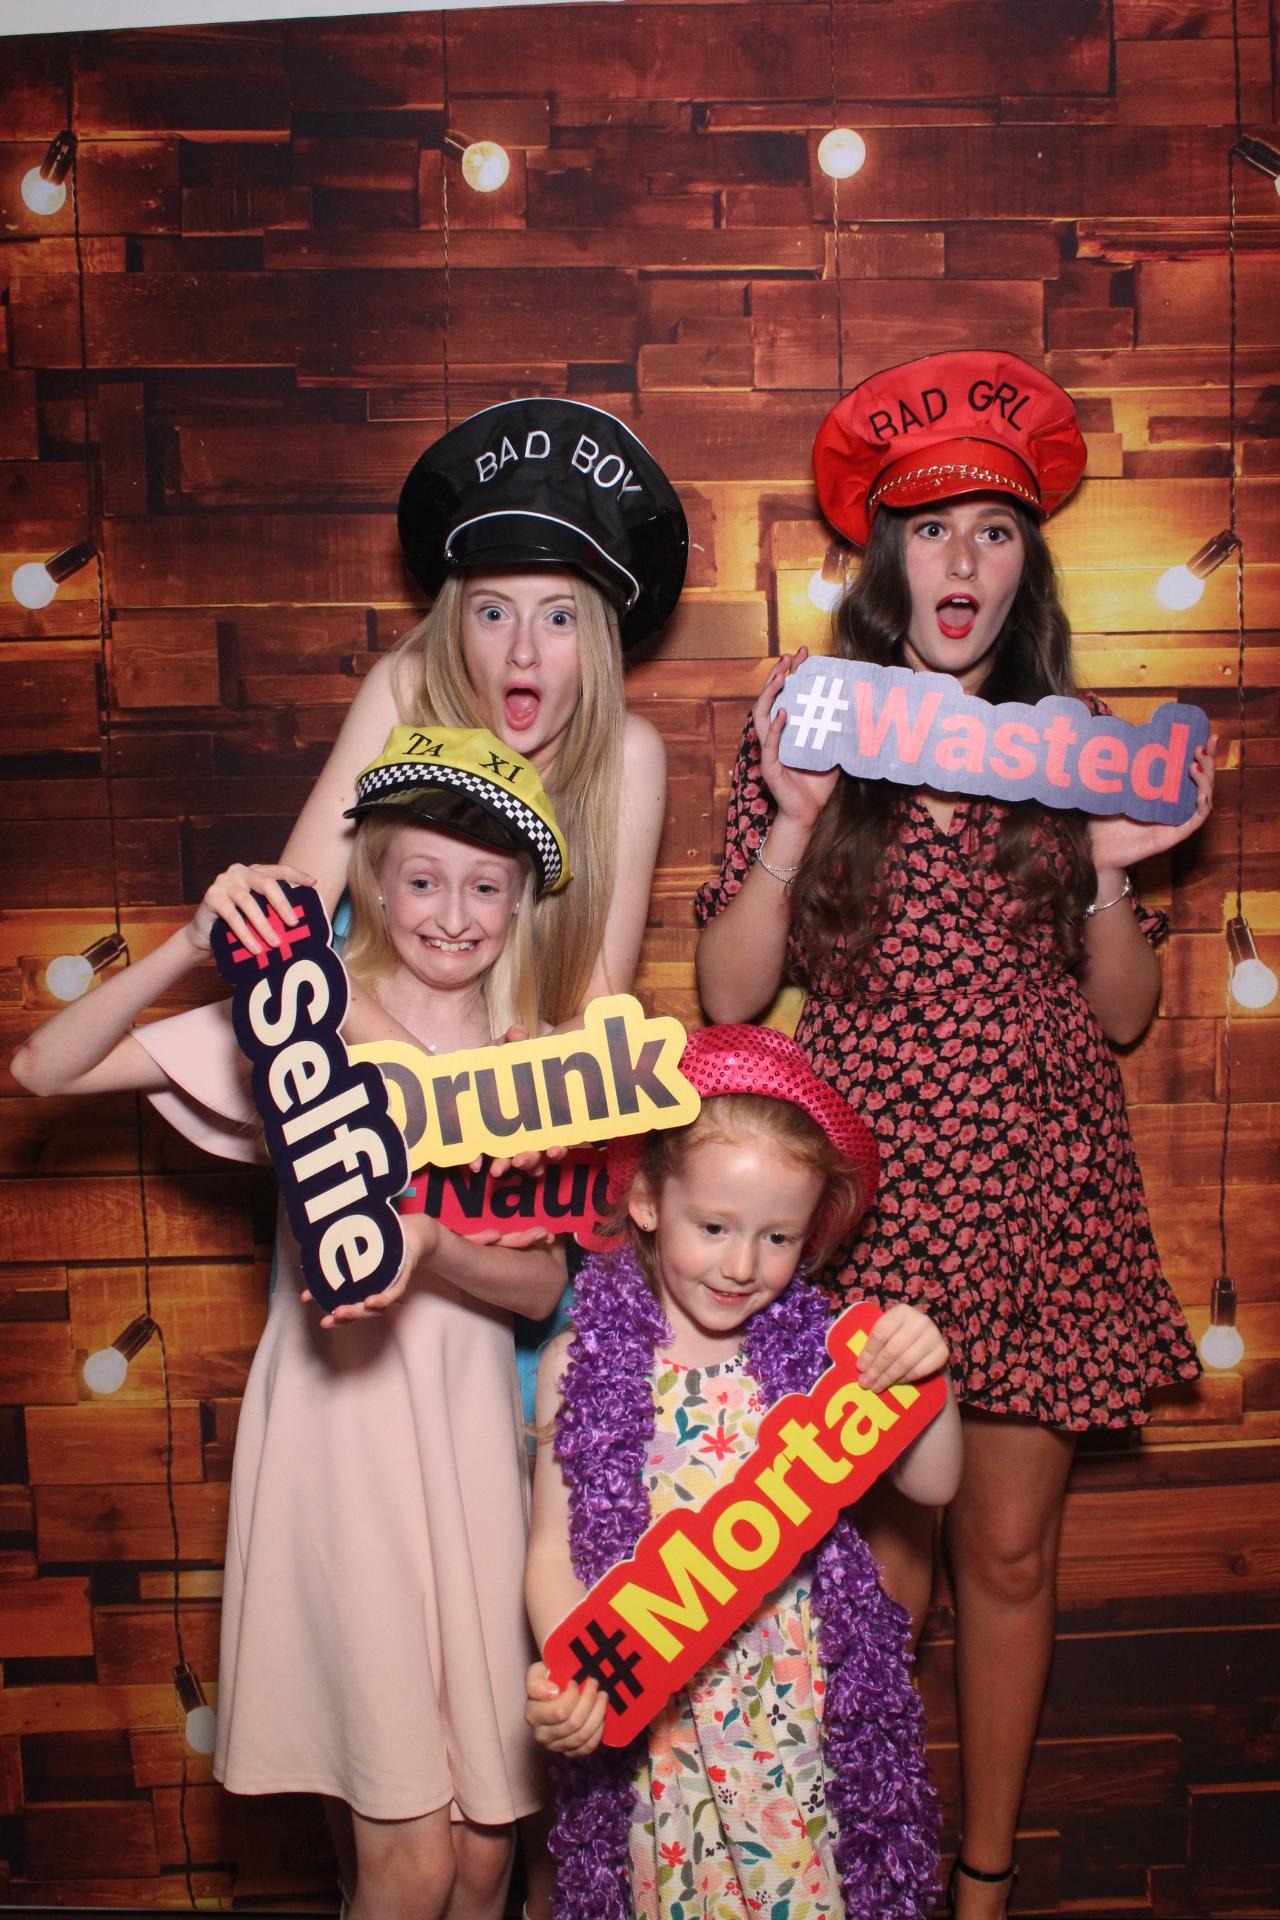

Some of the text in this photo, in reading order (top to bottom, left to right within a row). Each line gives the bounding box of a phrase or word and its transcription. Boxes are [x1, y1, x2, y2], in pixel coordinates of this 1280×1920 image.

[868, 379, 1032, 441] BAD GRL
[474, 430, 643, 501] BAD BOY
[789, 675, 1190, 804] #Wasted
[226, 904, 390, 1291] #Selfie
